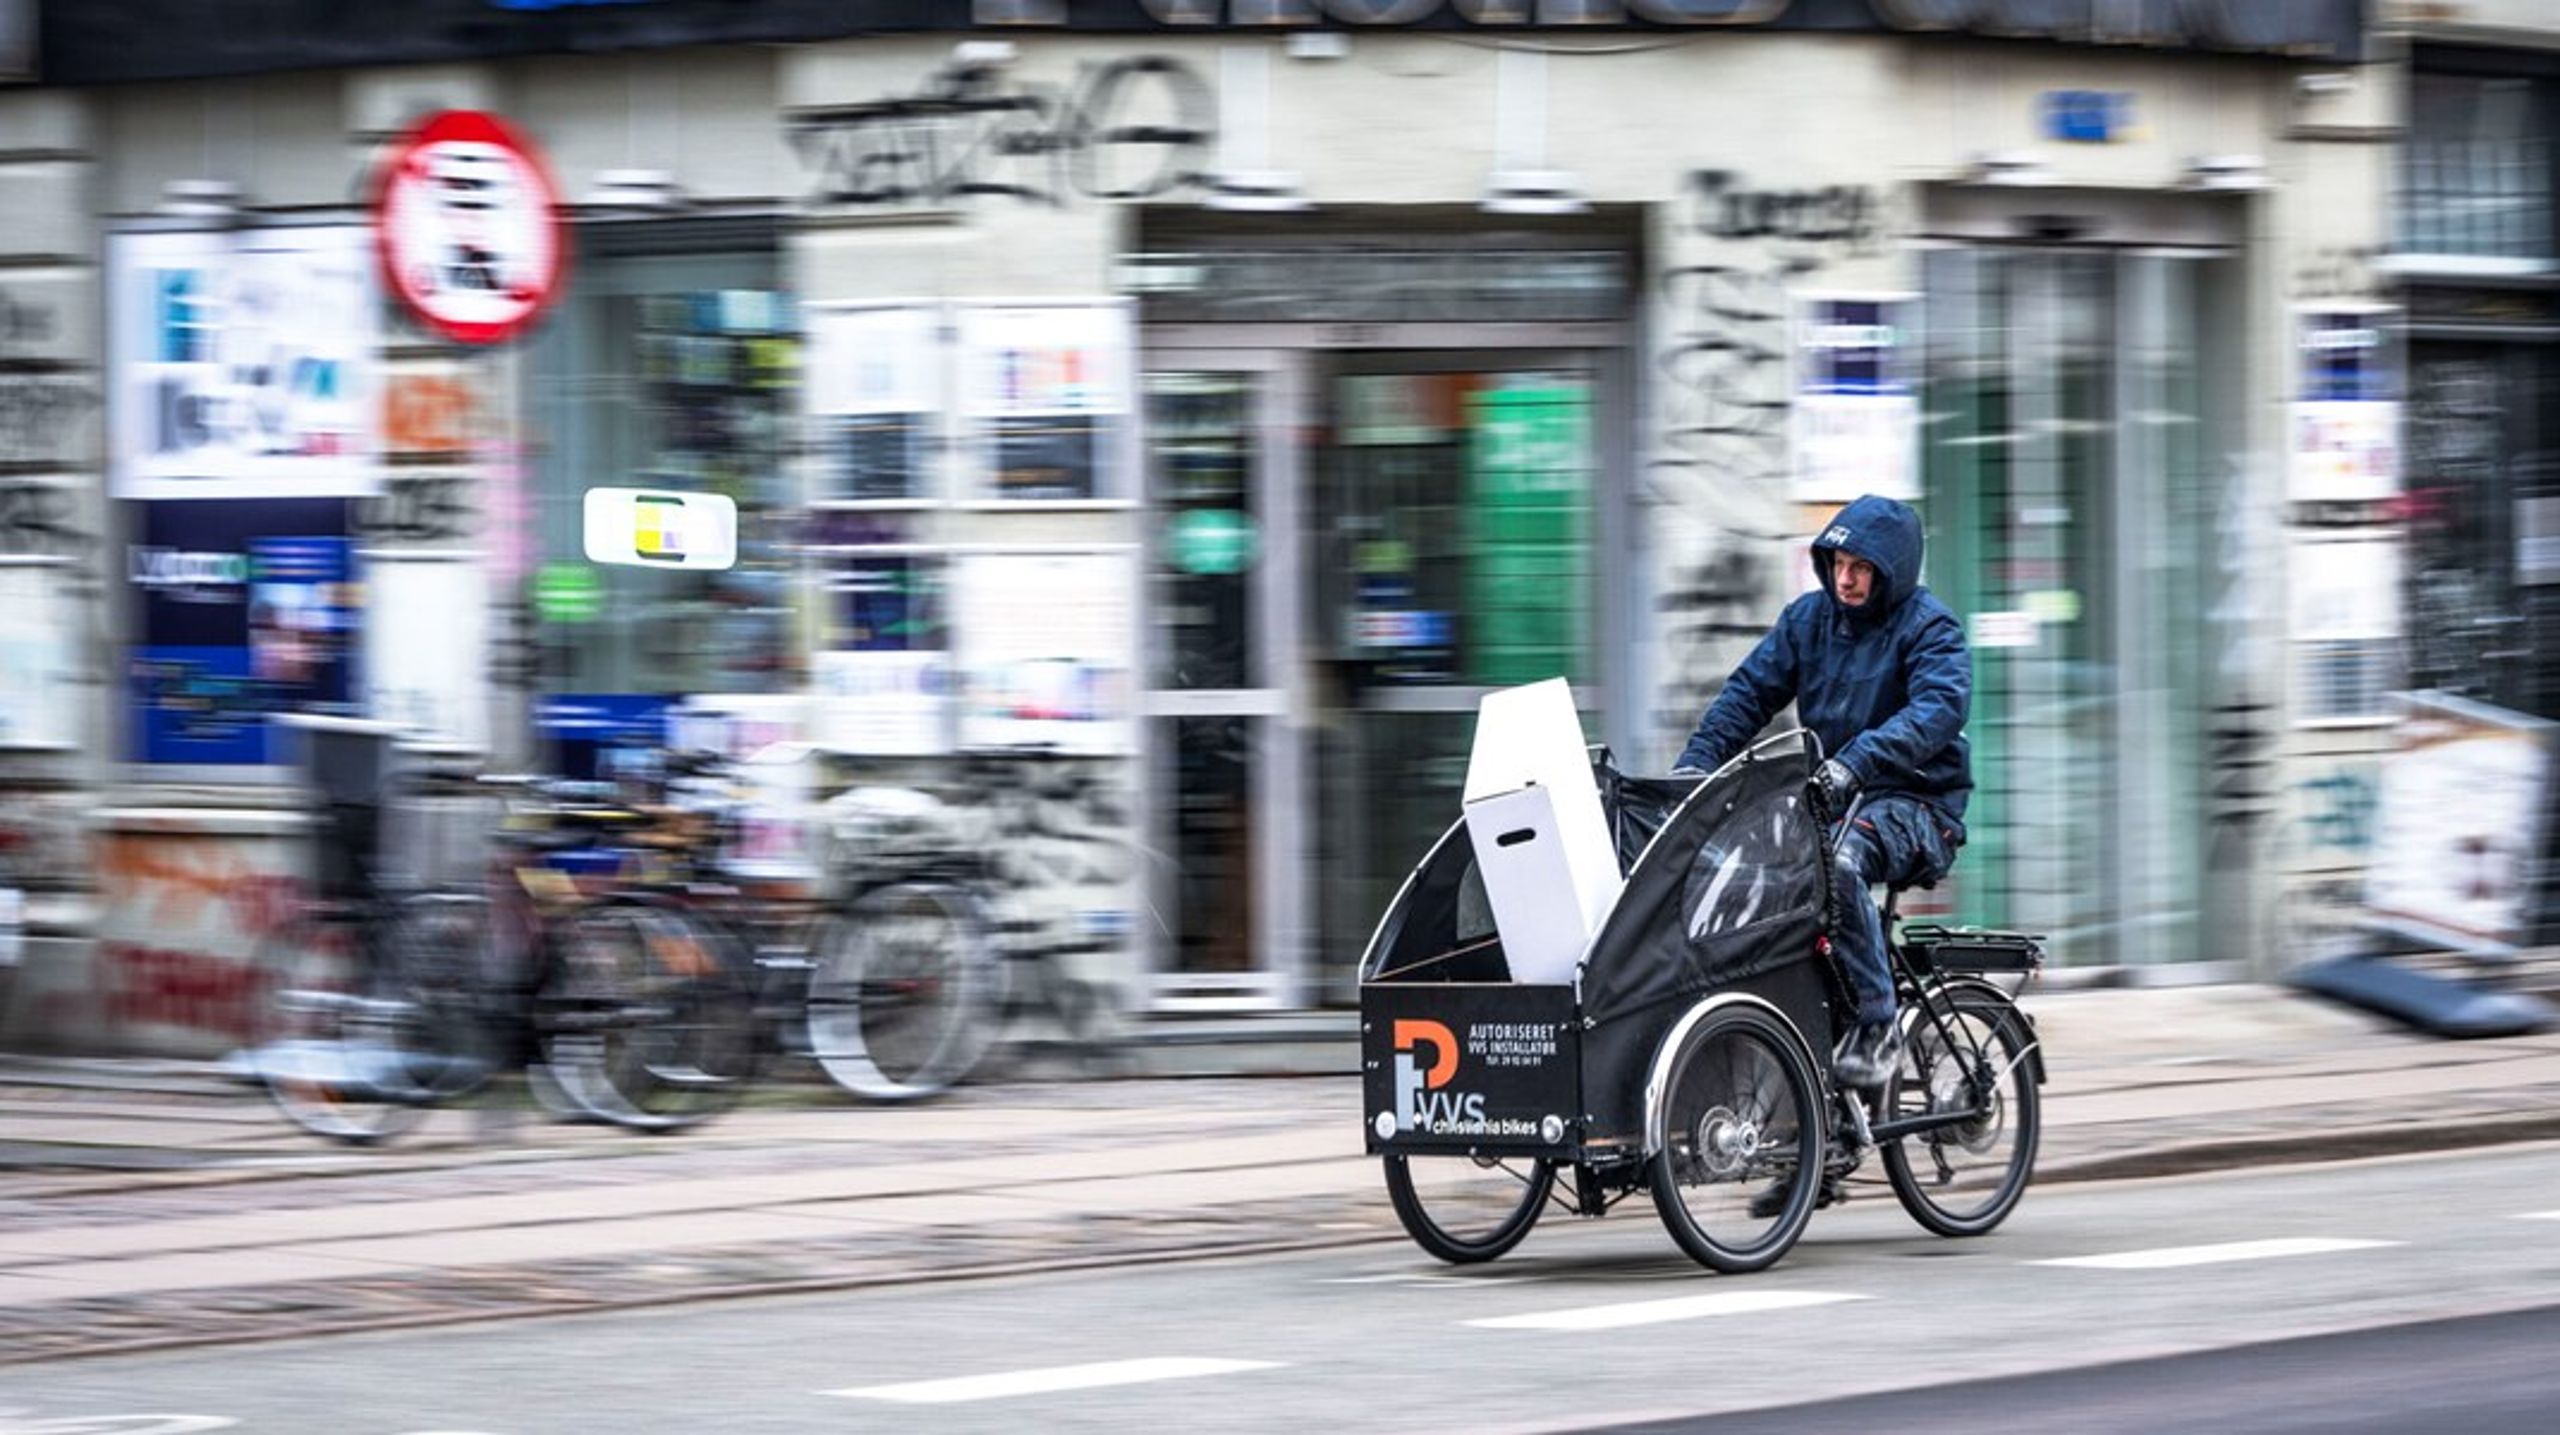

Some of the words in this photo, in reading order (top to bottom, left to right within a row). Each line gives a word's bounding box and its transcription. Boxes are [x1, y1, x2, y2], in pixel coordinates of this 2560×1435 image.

[1469, 1023, 1555, 1040] AUTORISERET
[1468, 1041, 1487, 1054] VVS
[1490, 1041, 1556, 1055] INSTALLATØR
[1416, 1092, 1486, 1131] VVS
[1502, 1118, 1537, 1135] bikes
